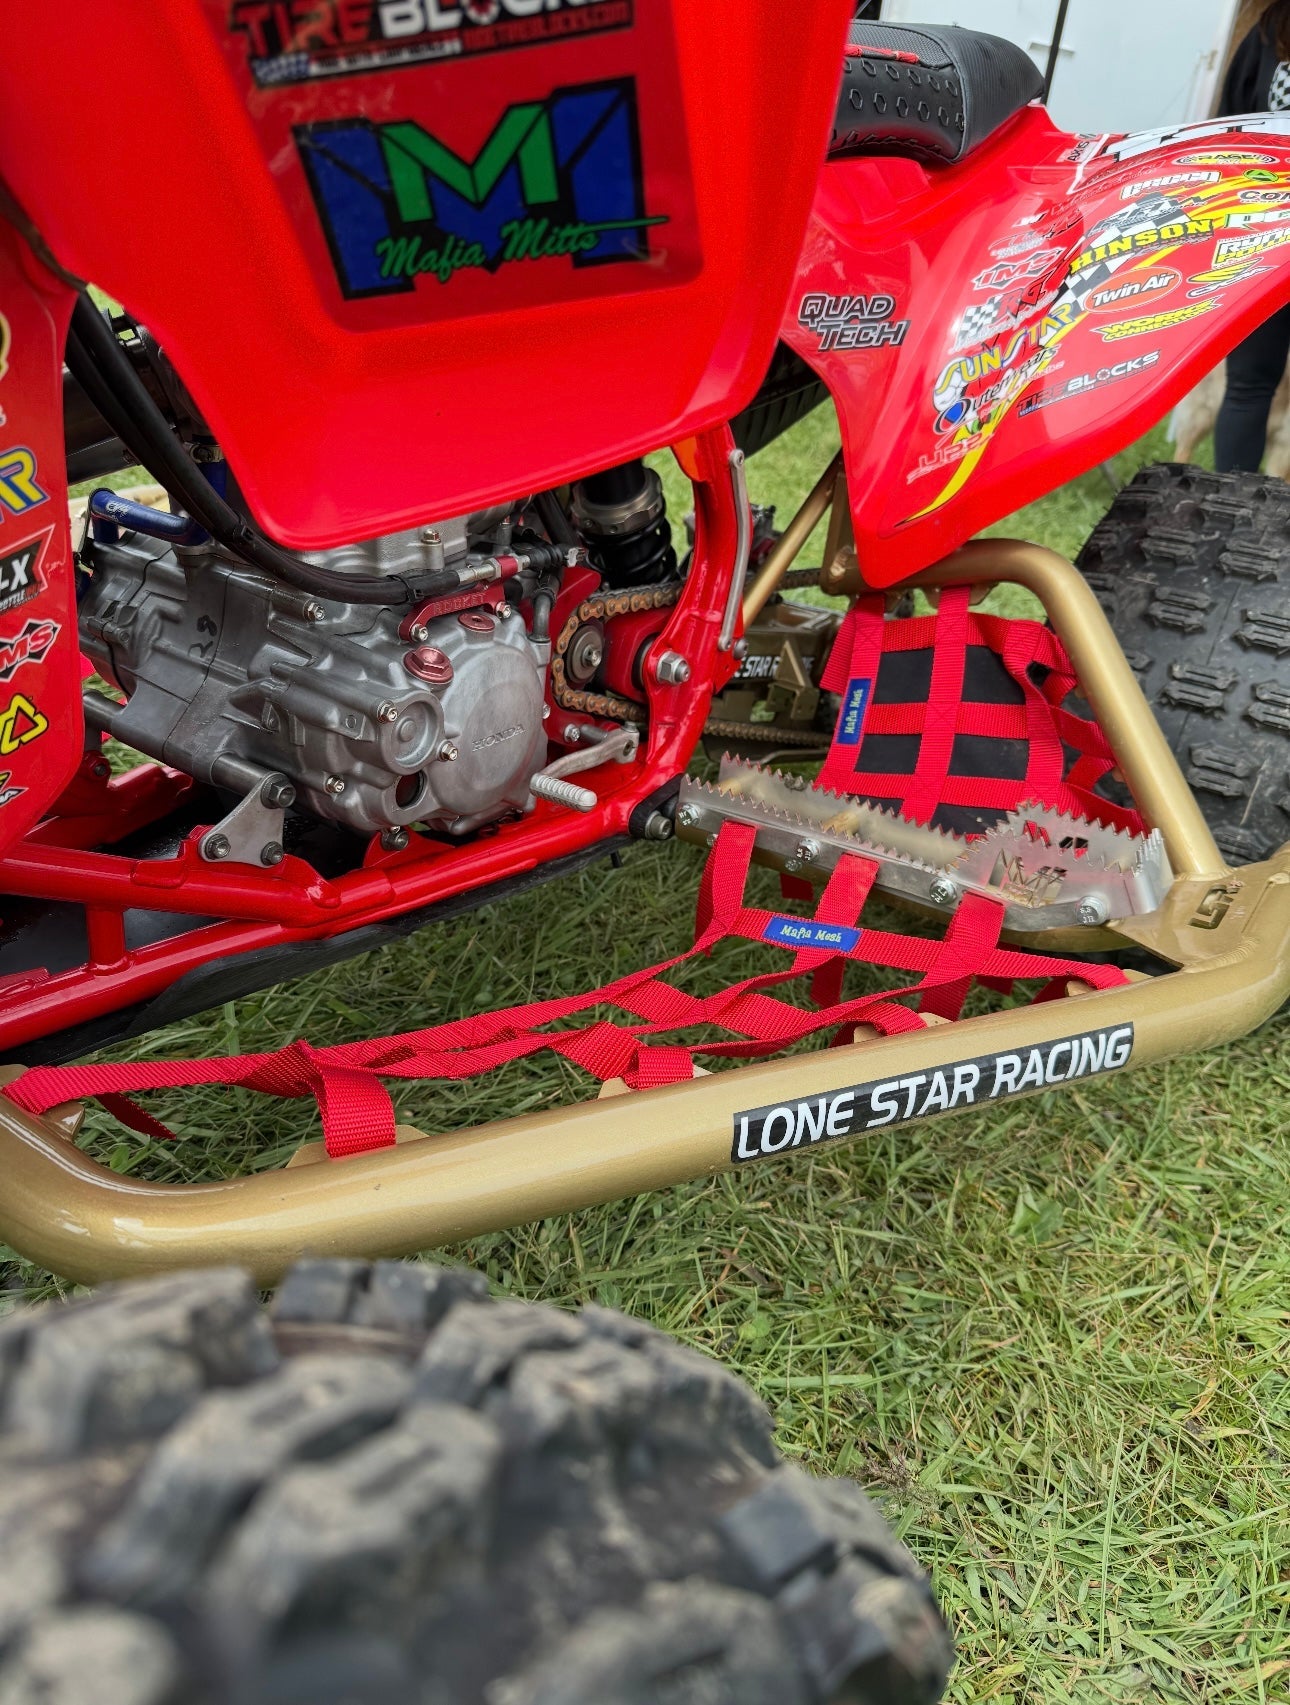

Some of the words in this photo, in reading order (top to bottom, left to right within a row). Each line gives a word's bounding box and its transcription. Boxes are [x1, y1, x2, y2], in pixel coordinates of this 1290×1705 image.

[376, 235, 485, 282] Mafia
[501, 216, 669, 260] Mitts
[1069, 218, 1214, 275] HINSON
[975, 249, 1062, 288] IMS
[1093, 282, 1141, 308] Twin
[1142, 273, 1177, 293] Air
[798, 292, 895, 327] QUAD
[817, 320, 911, 351] TECH
[741, 655, 772, 678] STAR
[472, 723, 526, 752] HONDA
[780, 924, 813, 940] Mafia
[814, 929, 843, 943] Mesh
[737, 1091, 855, 1159] LONE
[866, 1063, 980, 1129] STAR
[990, 1026, 1132, 1098] RACING
